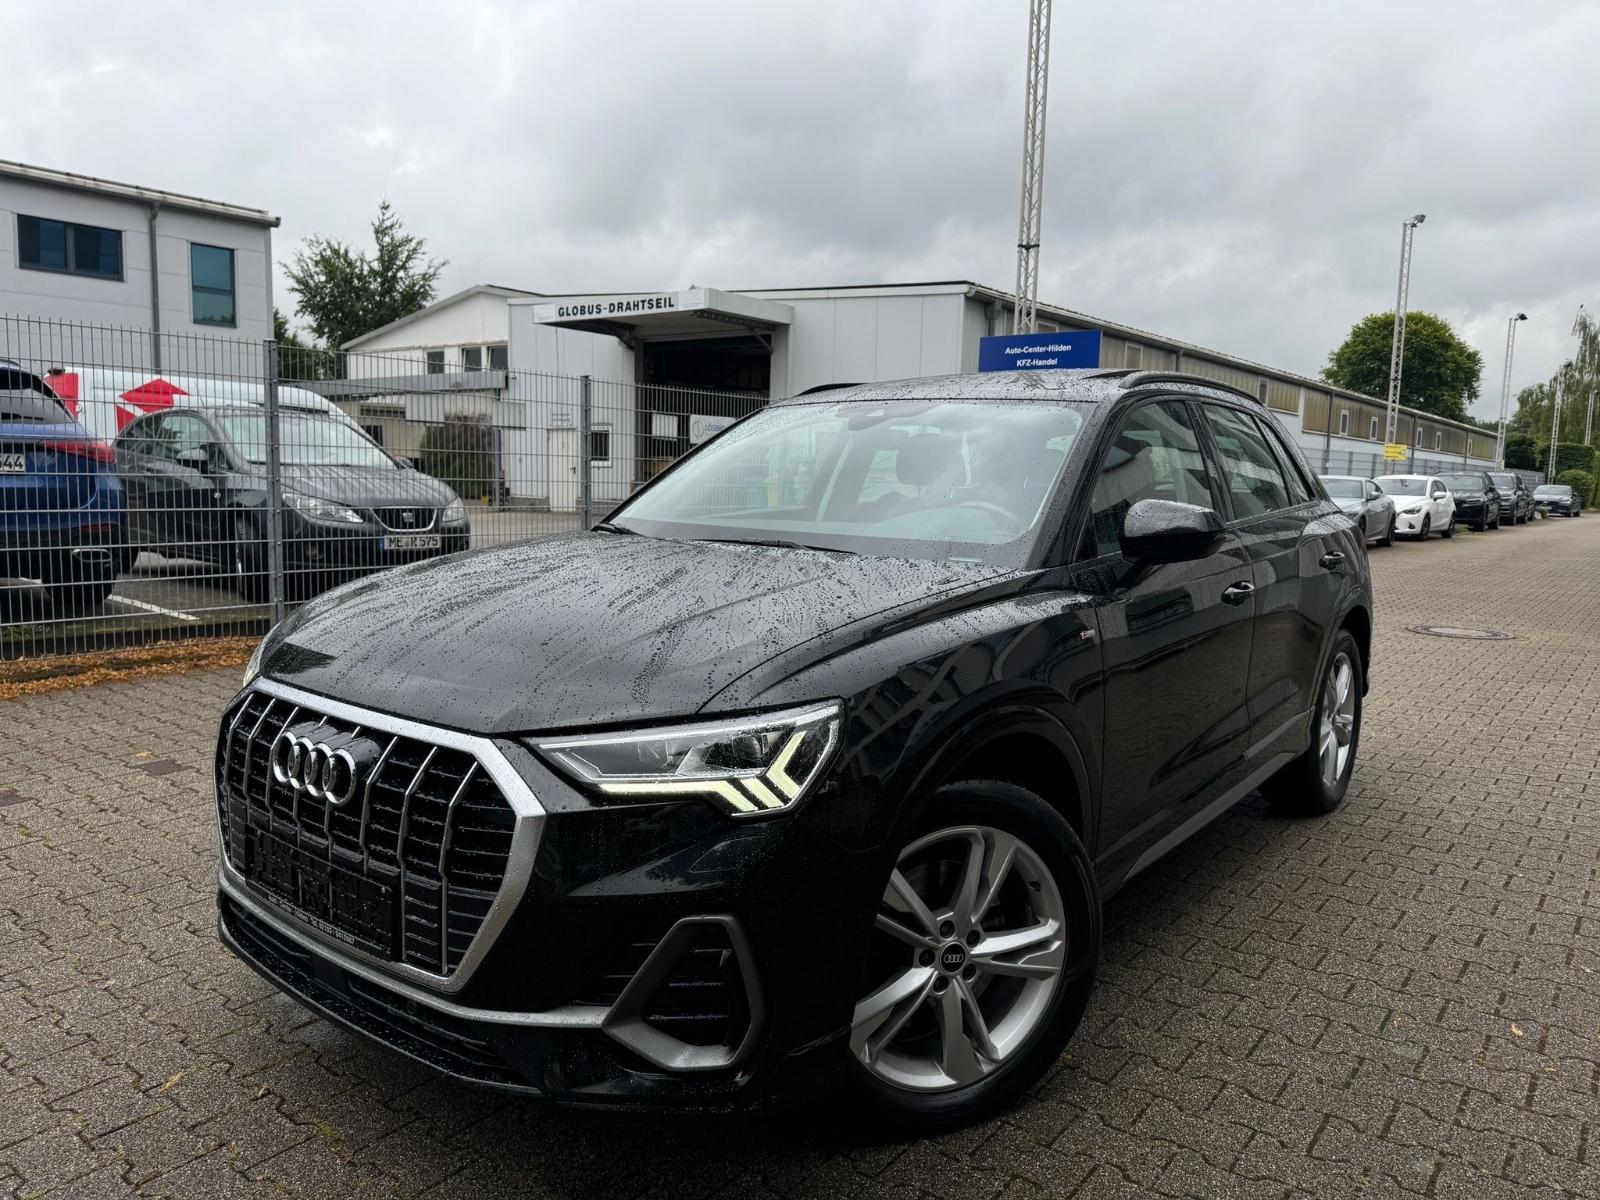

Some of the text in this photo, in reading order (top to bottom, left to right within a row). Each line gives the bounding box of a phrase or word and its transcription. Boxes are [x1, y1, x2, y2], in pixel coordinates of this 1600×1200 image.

[558, 296, 675, 318] GLOBUS-DRAHTSEIL
[1004, 343, 1072, 355] Auto-Center-Hilden
[1016, 357, 1058, 367] KFZ-Handel
